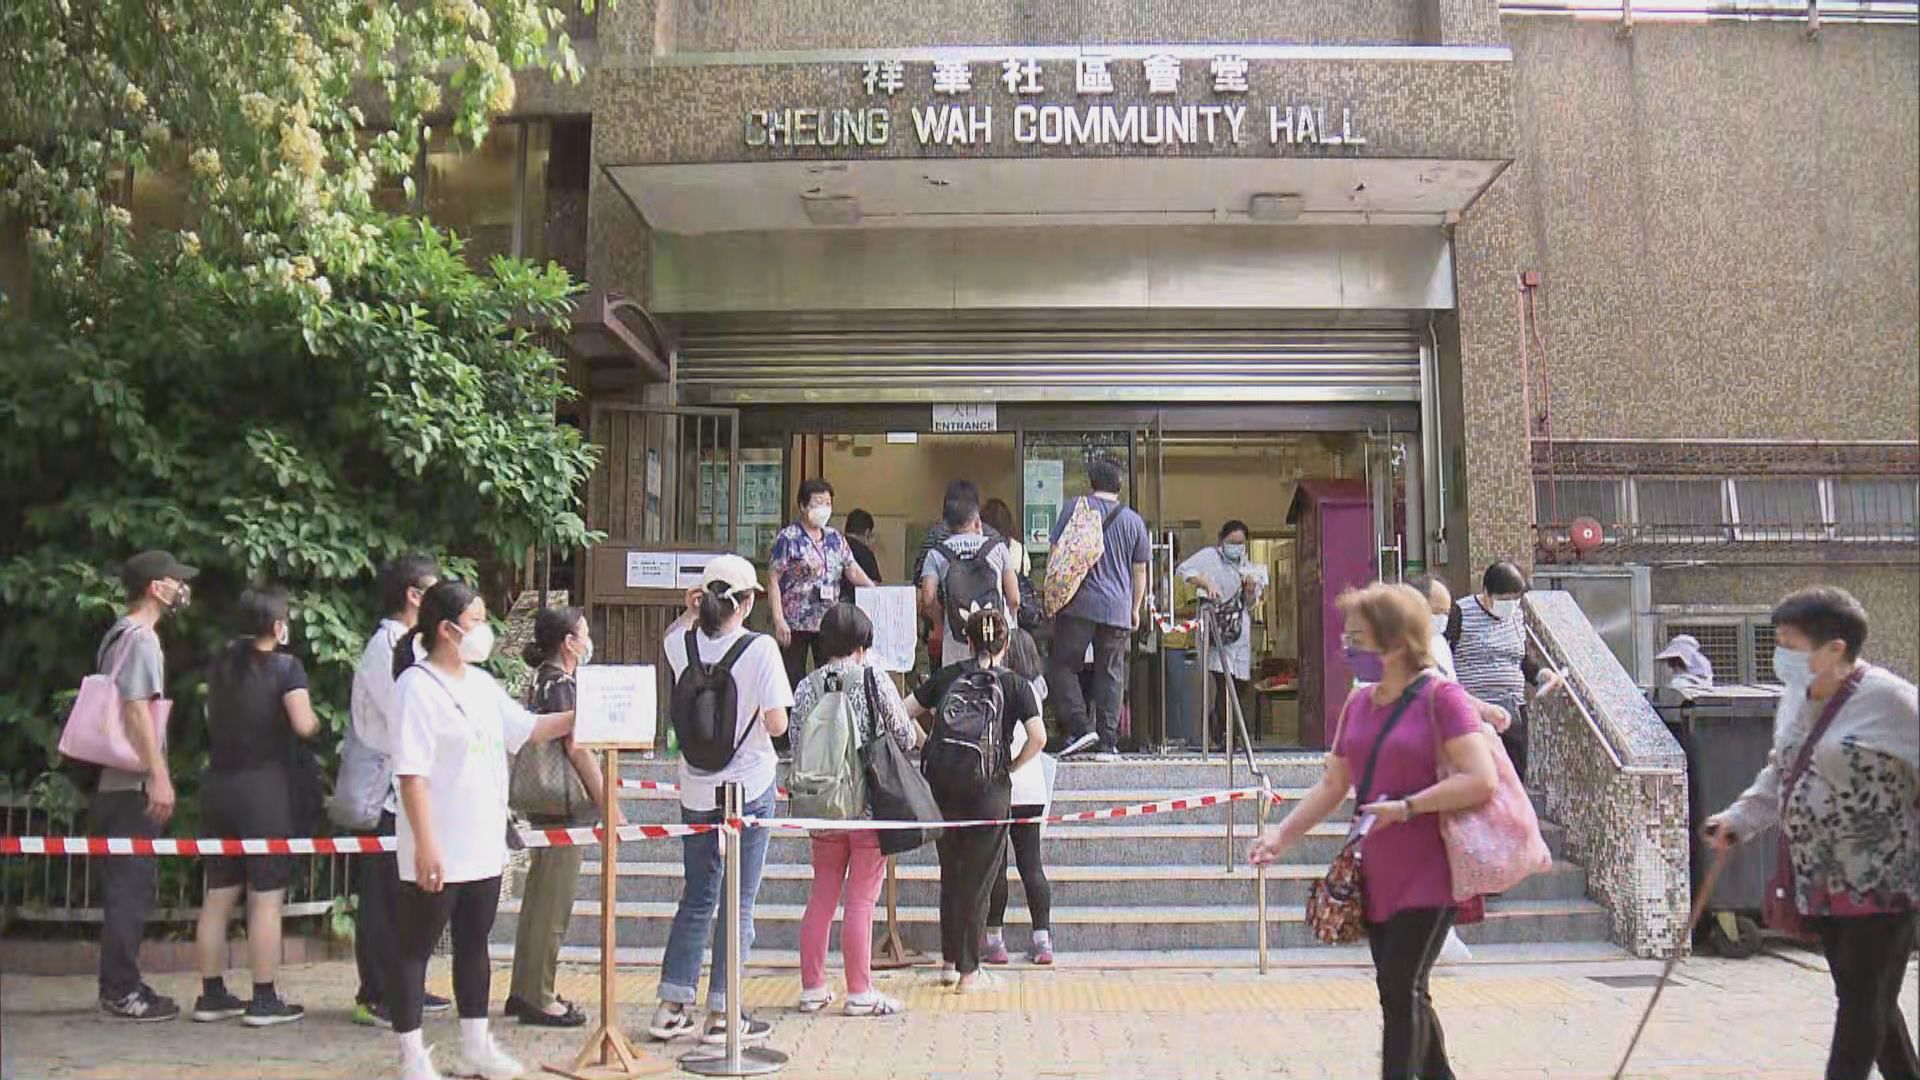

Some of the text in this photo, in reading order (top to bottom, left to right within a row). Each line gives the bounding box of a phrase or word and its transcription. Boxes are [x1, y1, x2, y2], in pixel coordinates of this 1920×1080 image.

[863, 55, 1249, 95] 祥華社區會堂
[745, 105, 1366, 146] CHEUNG WAH COMMUNITY HALL
[935, 421, 993, 431] ENTRANCE
